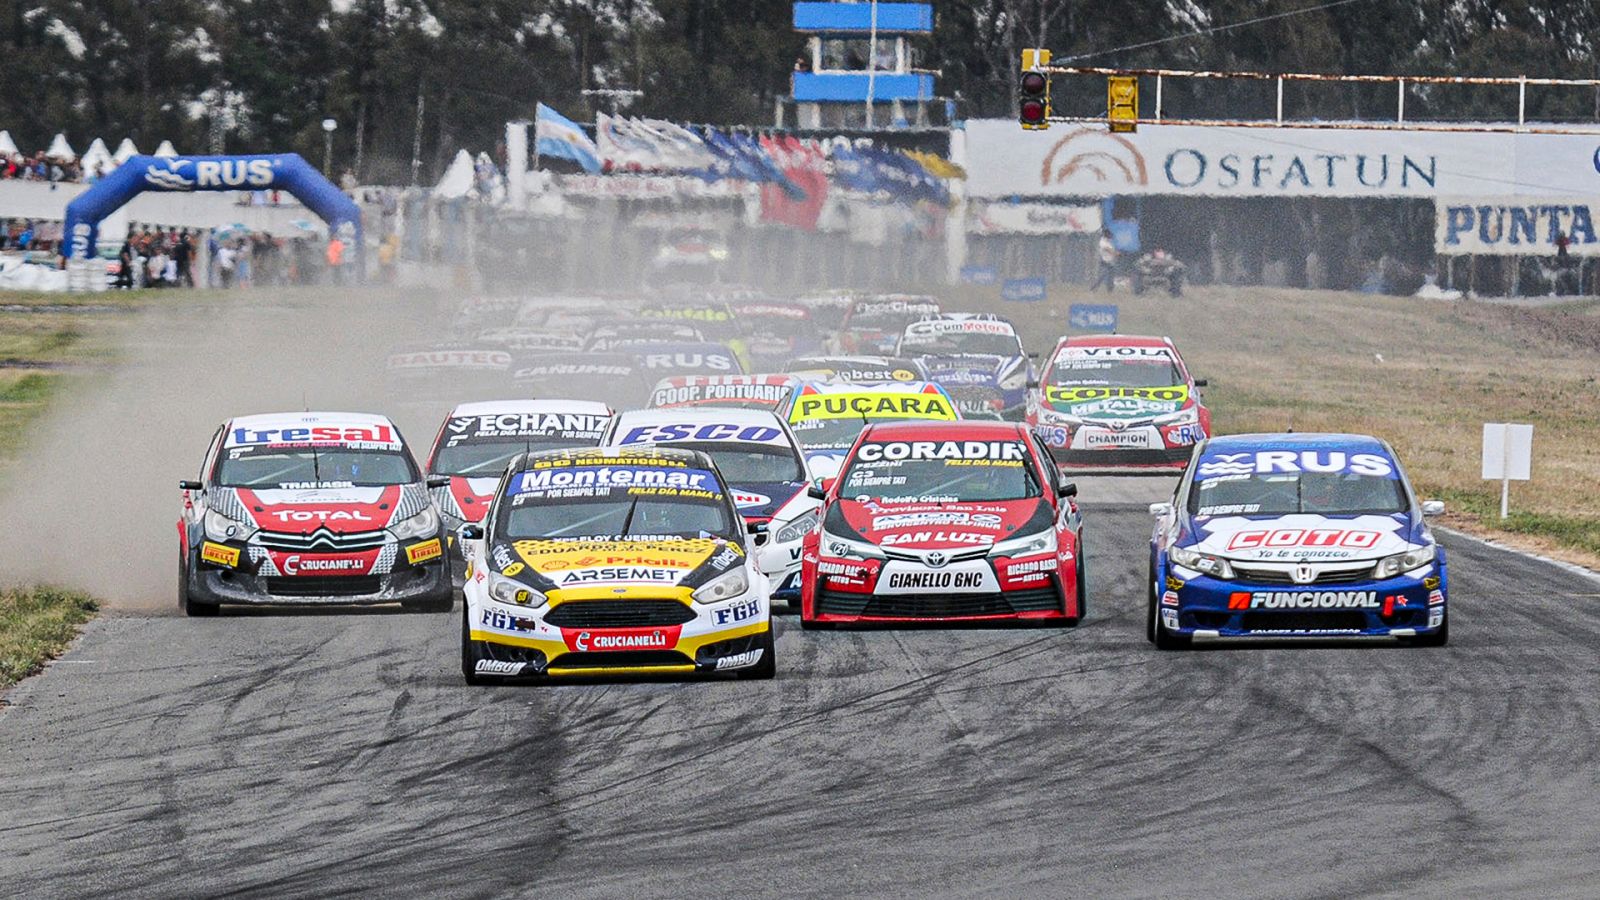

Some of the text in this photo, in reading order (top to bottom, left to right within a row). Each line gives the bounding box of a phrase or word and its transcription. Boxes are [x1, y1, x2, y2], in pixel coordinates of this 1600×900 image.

[197, 159, 274, 186] RUS
[1164, 149, 1437, 188] OSFATUN
[1445, 205, 1598, 246] PUNTA
[647, 353, 732, 371] RUS
[1050, 389, 1183, 401] COIRO
[802, 398, 946, 416] PUCARA
[233, 425, 394, 444] tresal
[620, 424, 782, 445] ESCO
[1088, 434, 1147, 444] CHAMPION
[857, 442, 1025, 460] CORADIR
[1256, 451, 1392, 476] RUS
[521, 466, 706, 488] Montemar
[848, 478, 863, 487] POR
[863, 477, 891, 486] SIEMPRE
[547, 487, 610, 498] POR SIEMPRE TATI
[272, 511, 371, 521] TOTAL
[881, 531, 995, 545] SAN LUIS
[1229, 530, 1382, 550] COTO
[1259, 550, 1273, 558] Yo
[563, 569, 678, 583] ARSEMET
[889, 573, 952, 588] GIANELLO
[1250, 591, 1380, 608] FUNCIONAL
[715, 600, 759, 624] FGH
[594, 635, 665, 646] CRUCIANELLI
